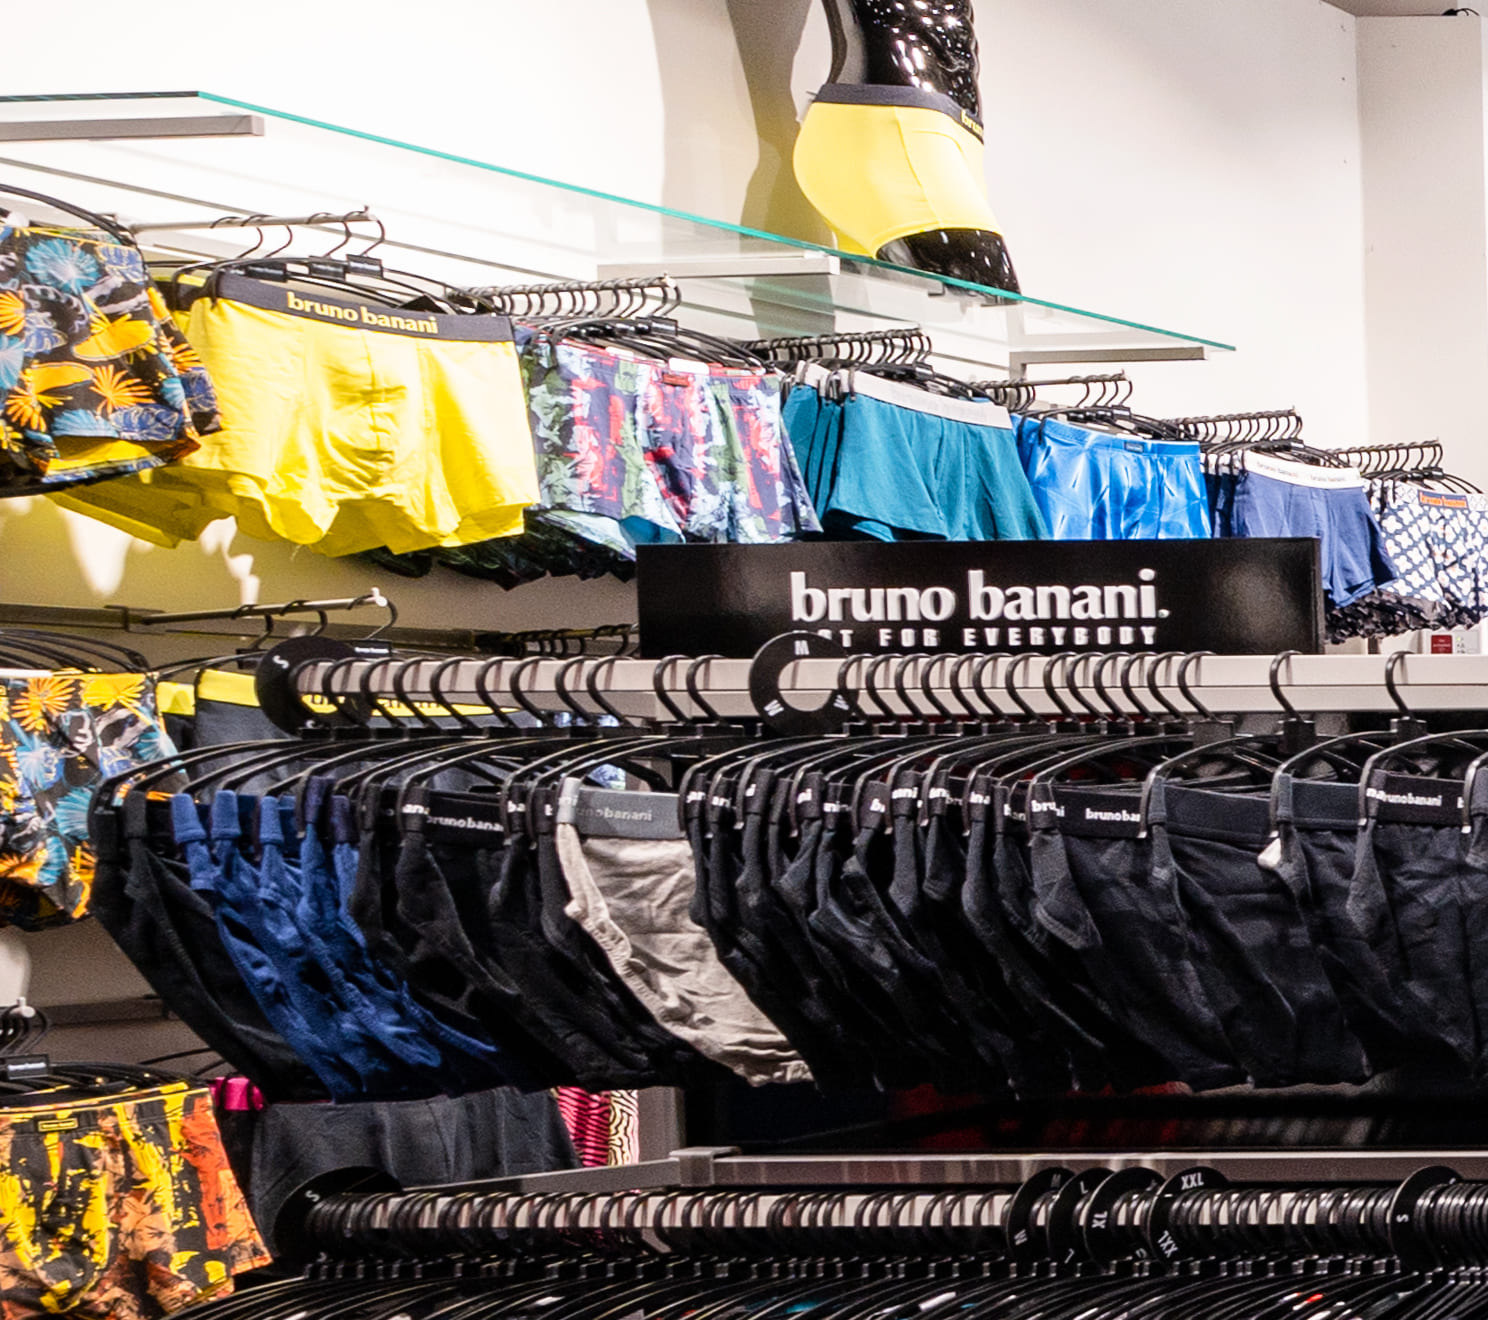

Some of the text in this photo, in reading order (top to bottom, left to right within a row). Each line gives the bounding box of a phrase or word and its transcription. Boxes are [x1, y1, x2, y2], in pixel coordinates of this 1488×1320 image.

[286, 292, 438, 334] bruno banani
[790, 571, 957, 622] bruno
[878, 627, 941, 648] FOR
[962, 625, 1158, 647] EVERYBODY
[1181, 1172, 1204, 1191] XXL
